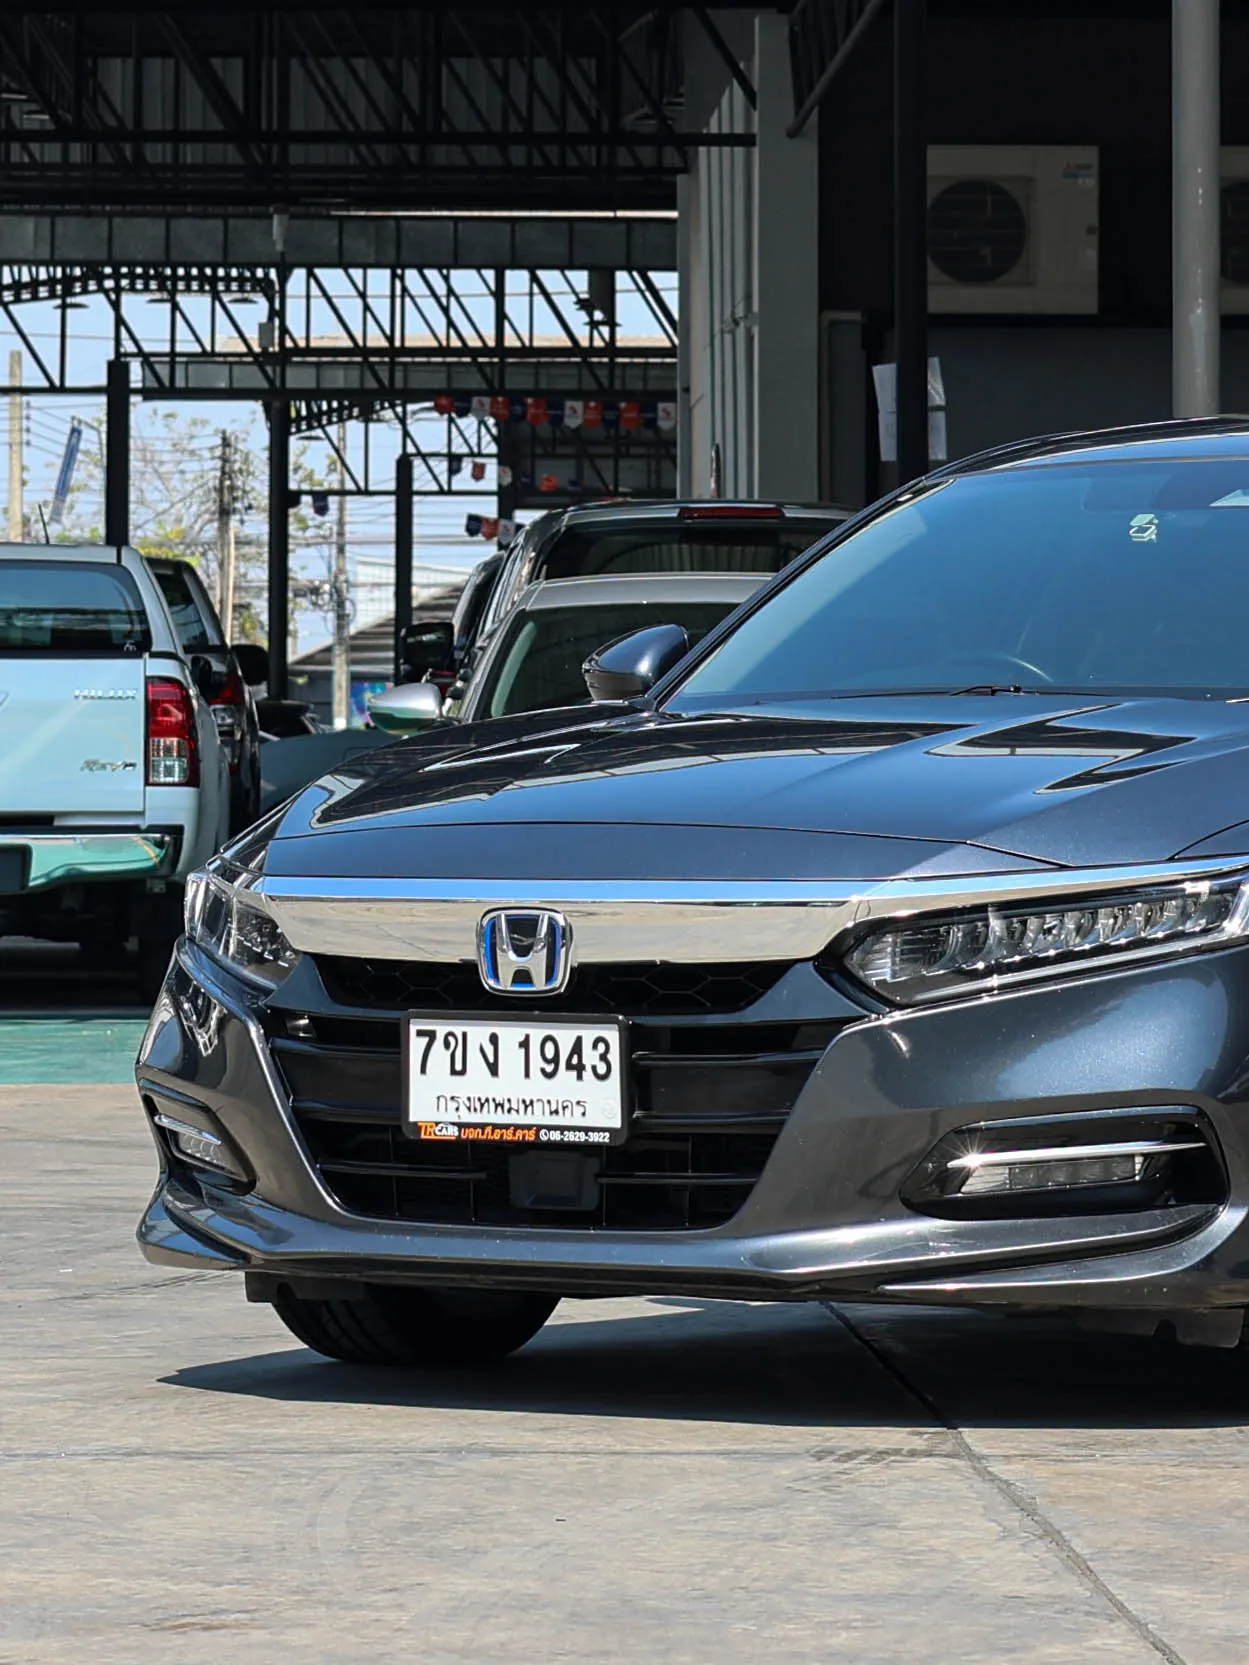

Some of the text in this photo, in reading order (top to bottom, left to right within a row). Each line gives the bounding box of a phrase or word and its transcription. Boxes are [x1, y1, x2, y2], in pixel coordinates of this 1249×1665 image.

[518, 1033, 612, 1082] 1943
[436, 1093, 588, 1120] กรุงเทพมหานคร
